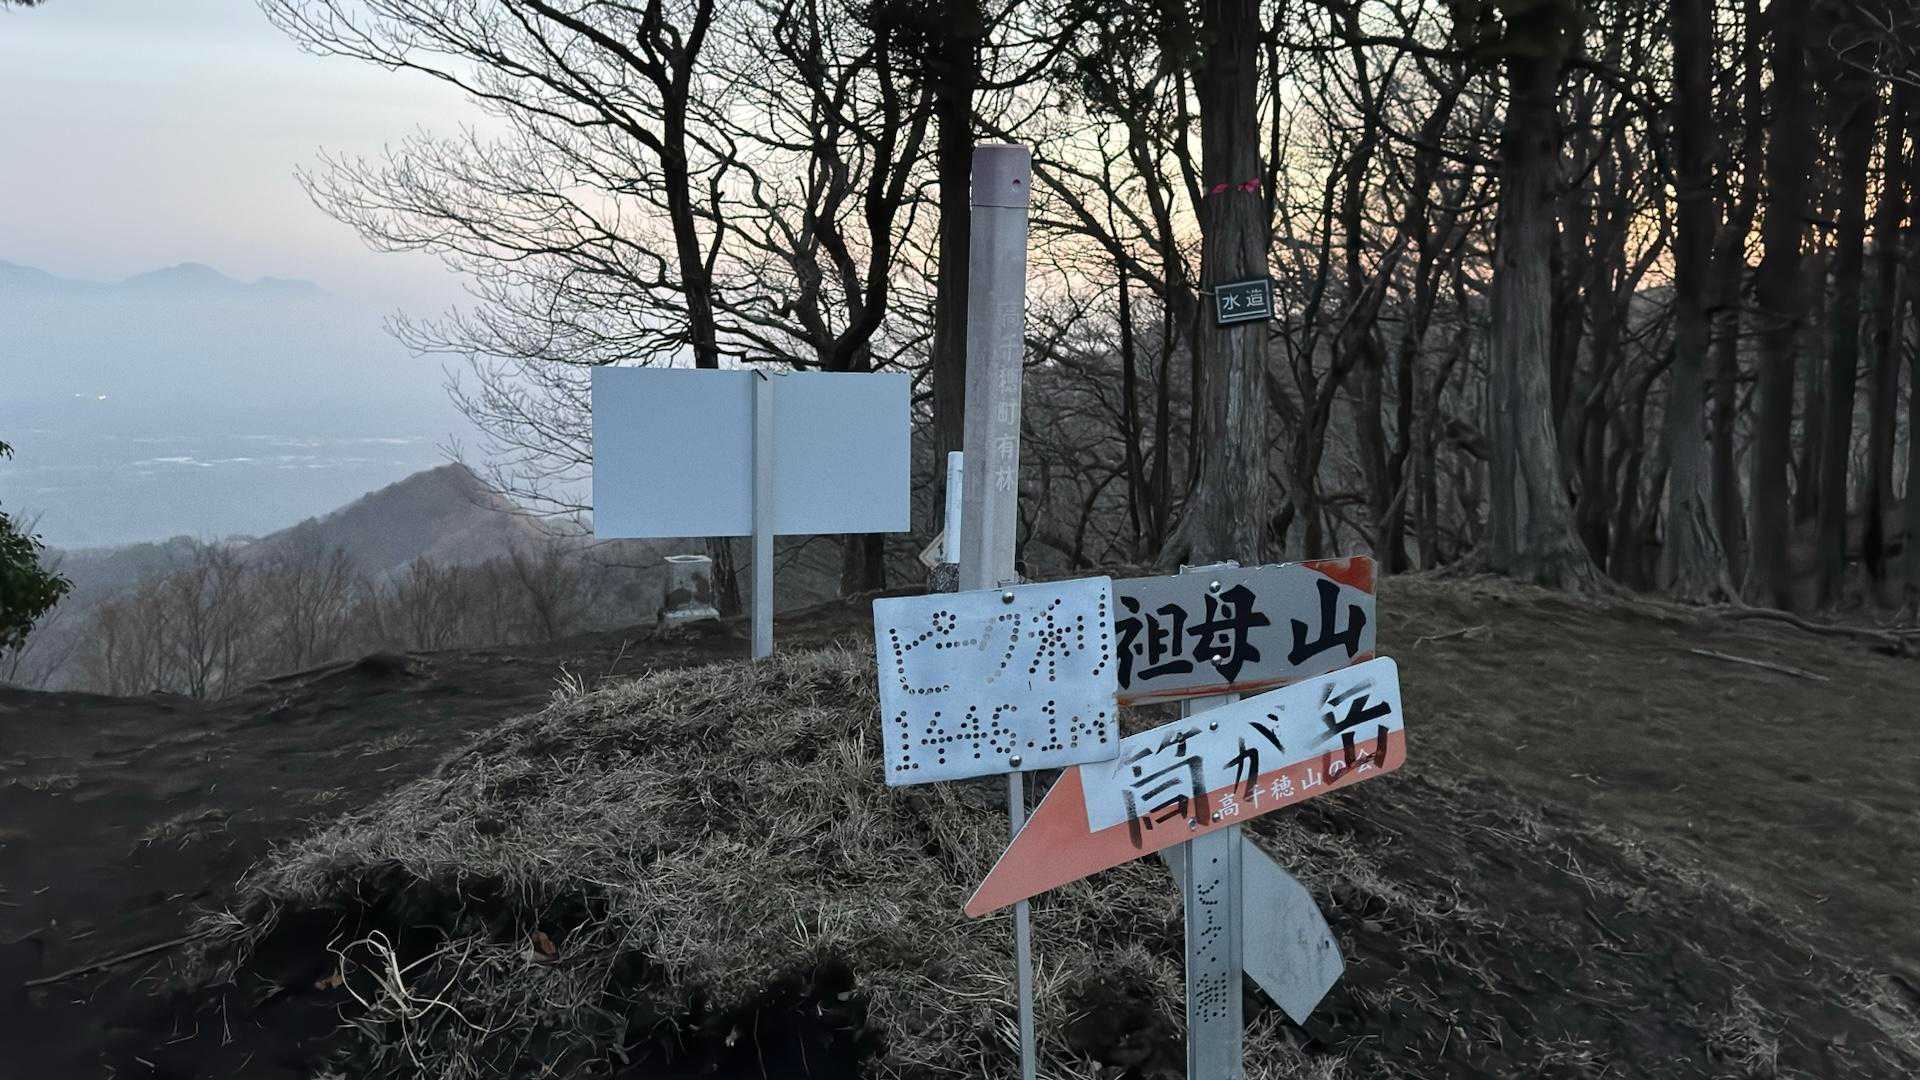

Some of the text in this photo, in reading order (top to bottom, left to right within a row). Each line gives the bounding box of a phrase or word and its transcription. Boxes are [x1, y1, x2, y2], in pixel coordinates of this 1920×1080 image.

[1115, 578, 1367, 690] 祖母山
[1121, 677, 1392, 850] 筒が岳
[1218, 748, 1377, 818] 高千穂山の会
